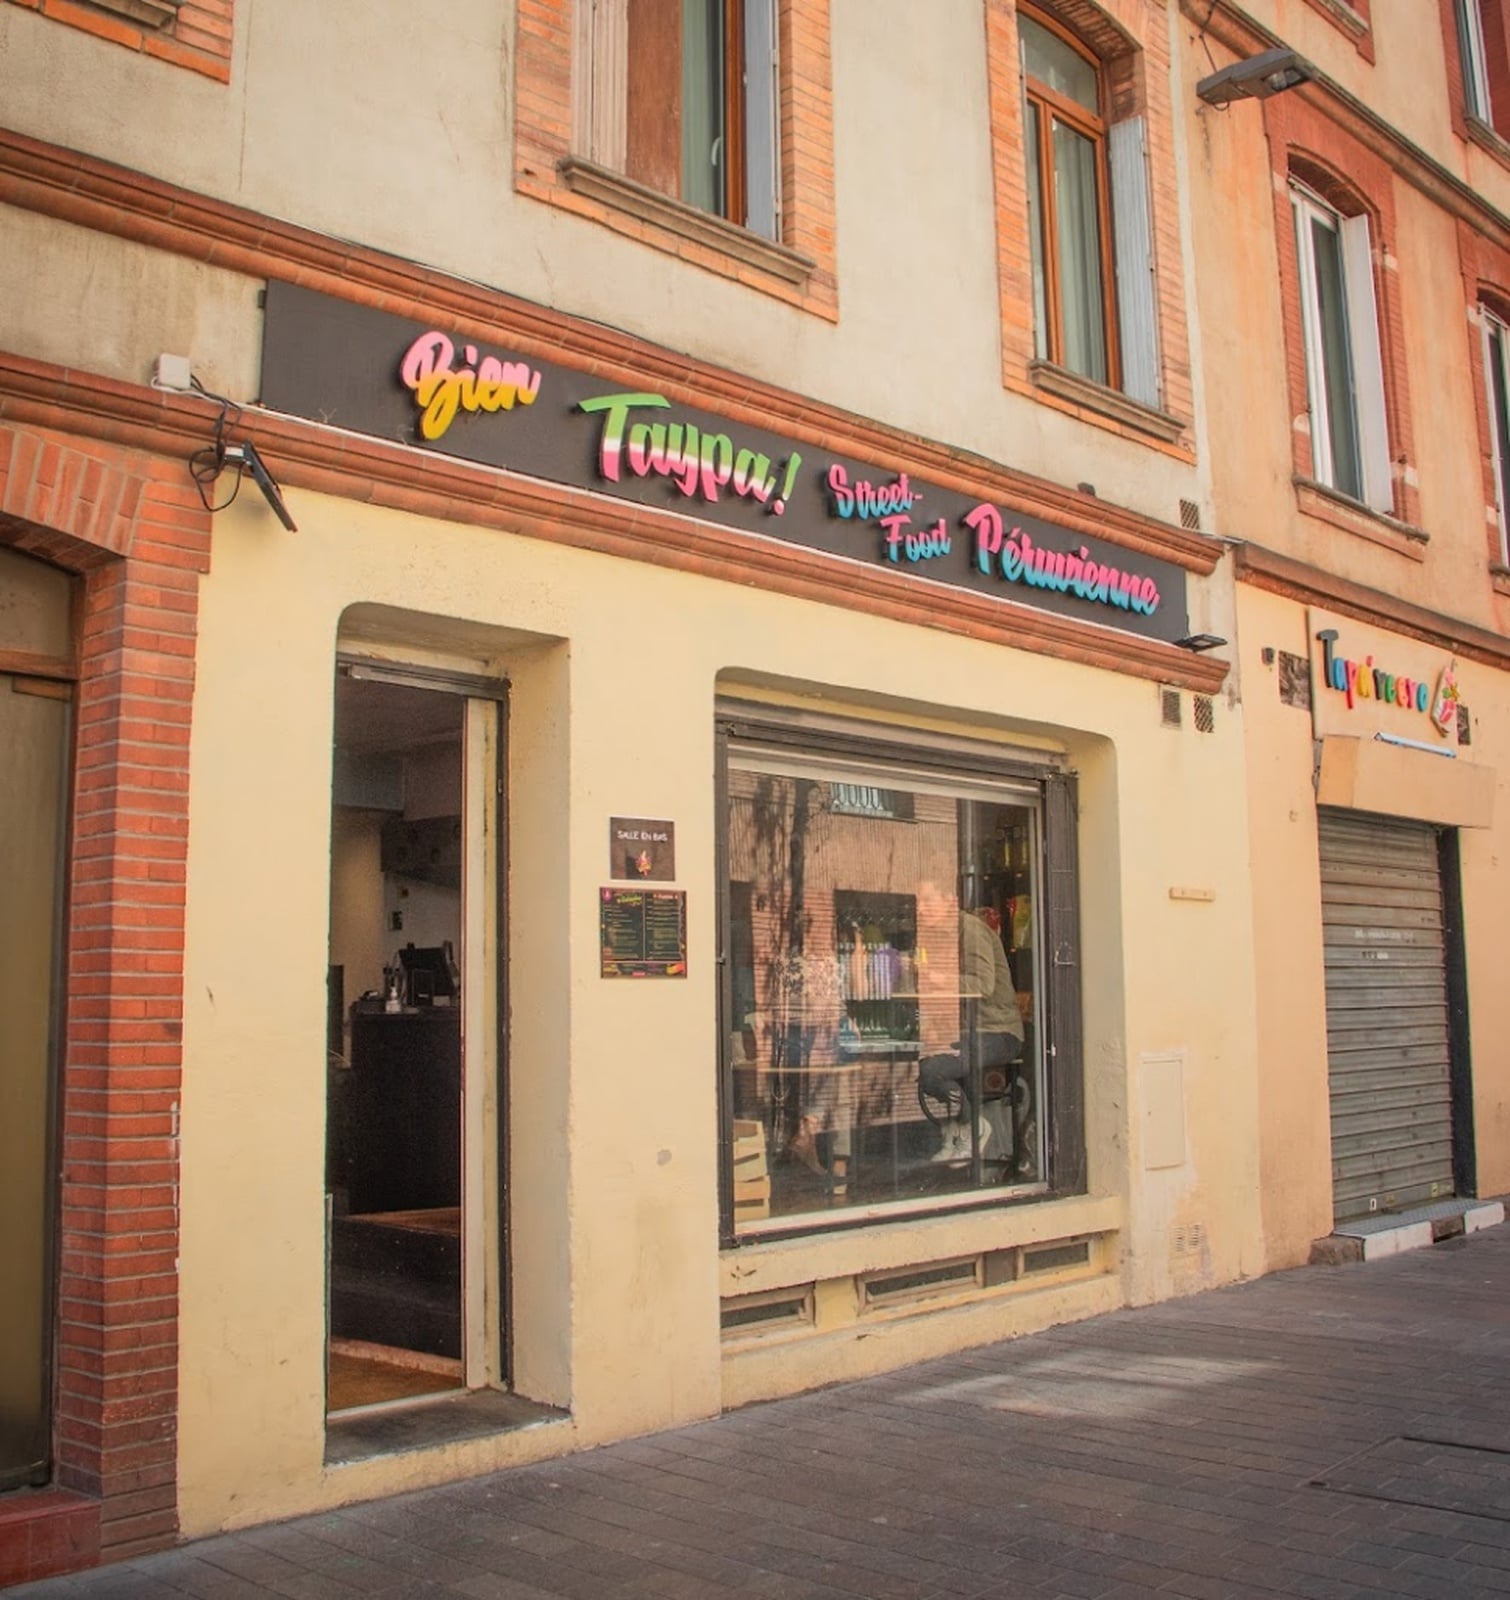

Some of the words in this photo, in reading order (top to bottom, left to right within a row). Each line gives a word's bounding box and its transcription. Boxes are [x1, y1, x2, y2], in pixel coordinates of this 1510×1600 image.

[401, 331, 541, 440] Bien
[578, 392, 801, 515] Taypa!
[880, 514, 951, 563] Food
[965, 502, 1160, 616] Péruvienne
[617, 830, 639, 840] SALLE
[640, 831, 652, 841] EN
[653, 832, 668, 842] BAS
